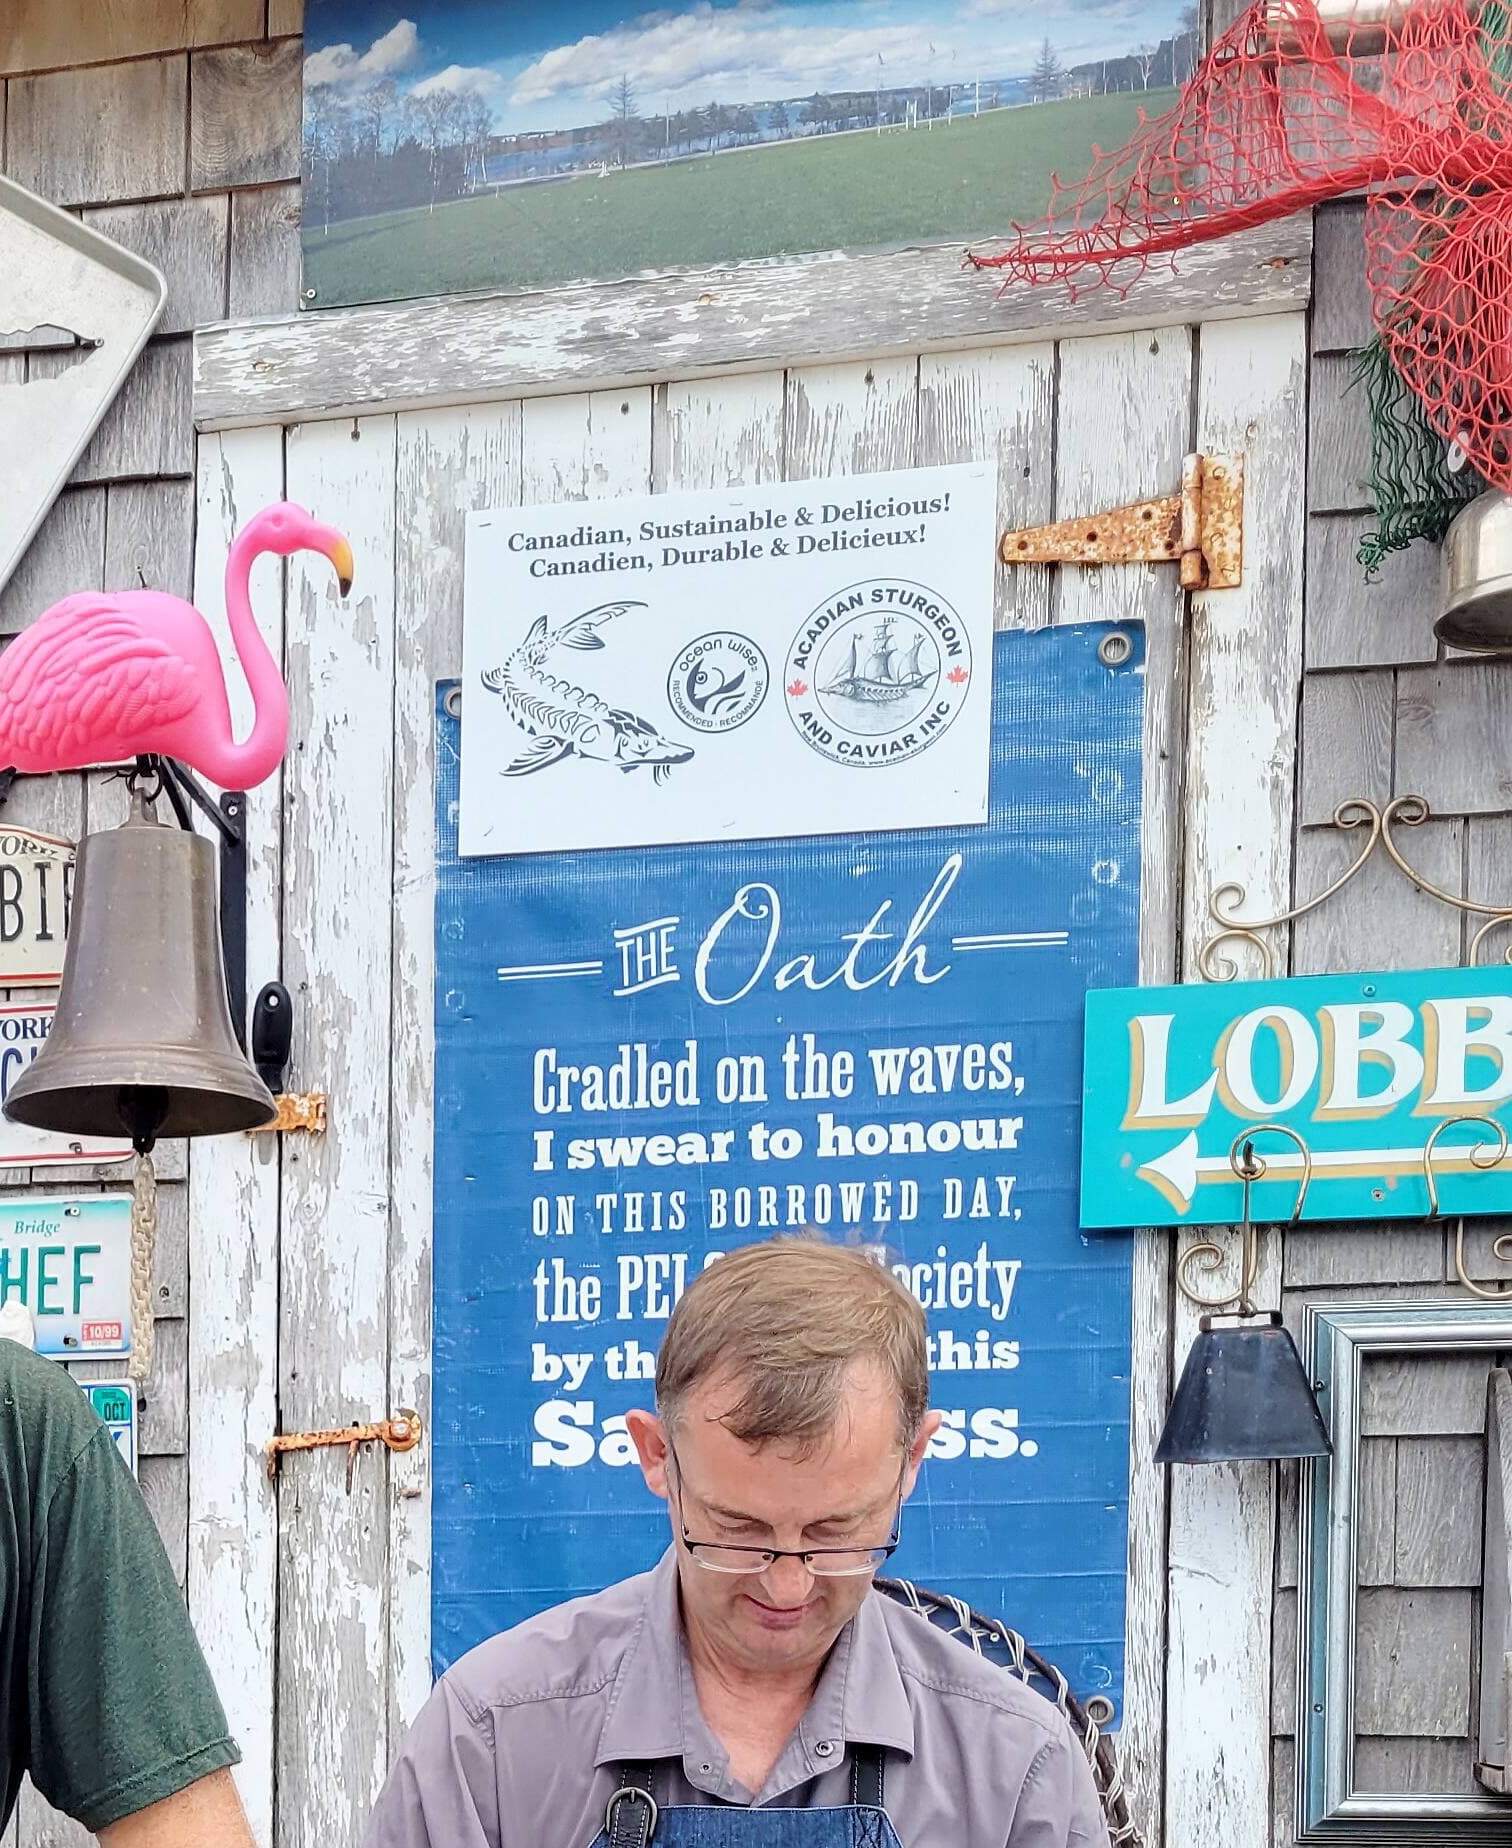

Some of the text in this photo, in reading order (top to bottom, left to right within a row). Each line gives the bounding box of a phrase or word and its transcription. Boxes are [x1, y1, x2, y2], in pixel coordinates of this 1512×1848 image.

[507, 493, 951, 553] Canadian, Sustainable & Delicious!
[529, 525, 925, 579] Canadien, Durable & Delicieux!
[679, 639, 722, 671] ocean
[793, 588, 963, 670] ACADIAN STURGEON
[672, 680, 713, 728] RECOMMENDED
[799, 700, 951, 759] AND CAVIAR INC
[617, 854, 962, 1006] THE Oath
[533, 1032, 1026, 1114] Cradled on the waves,
[533, 1113, 1025, 1171] I swear to honour
[14, 1220, 61, 1238] Bridge
[532, 1175, 1023, 1237] ON THIS BORROWED DAY,
[532, 1257, 601, 1322] the
[89, 1324, 120, 1338] 10/99
[531, 1343, 596, 1392] by
[103, 1401, 125, 1422] OCT
